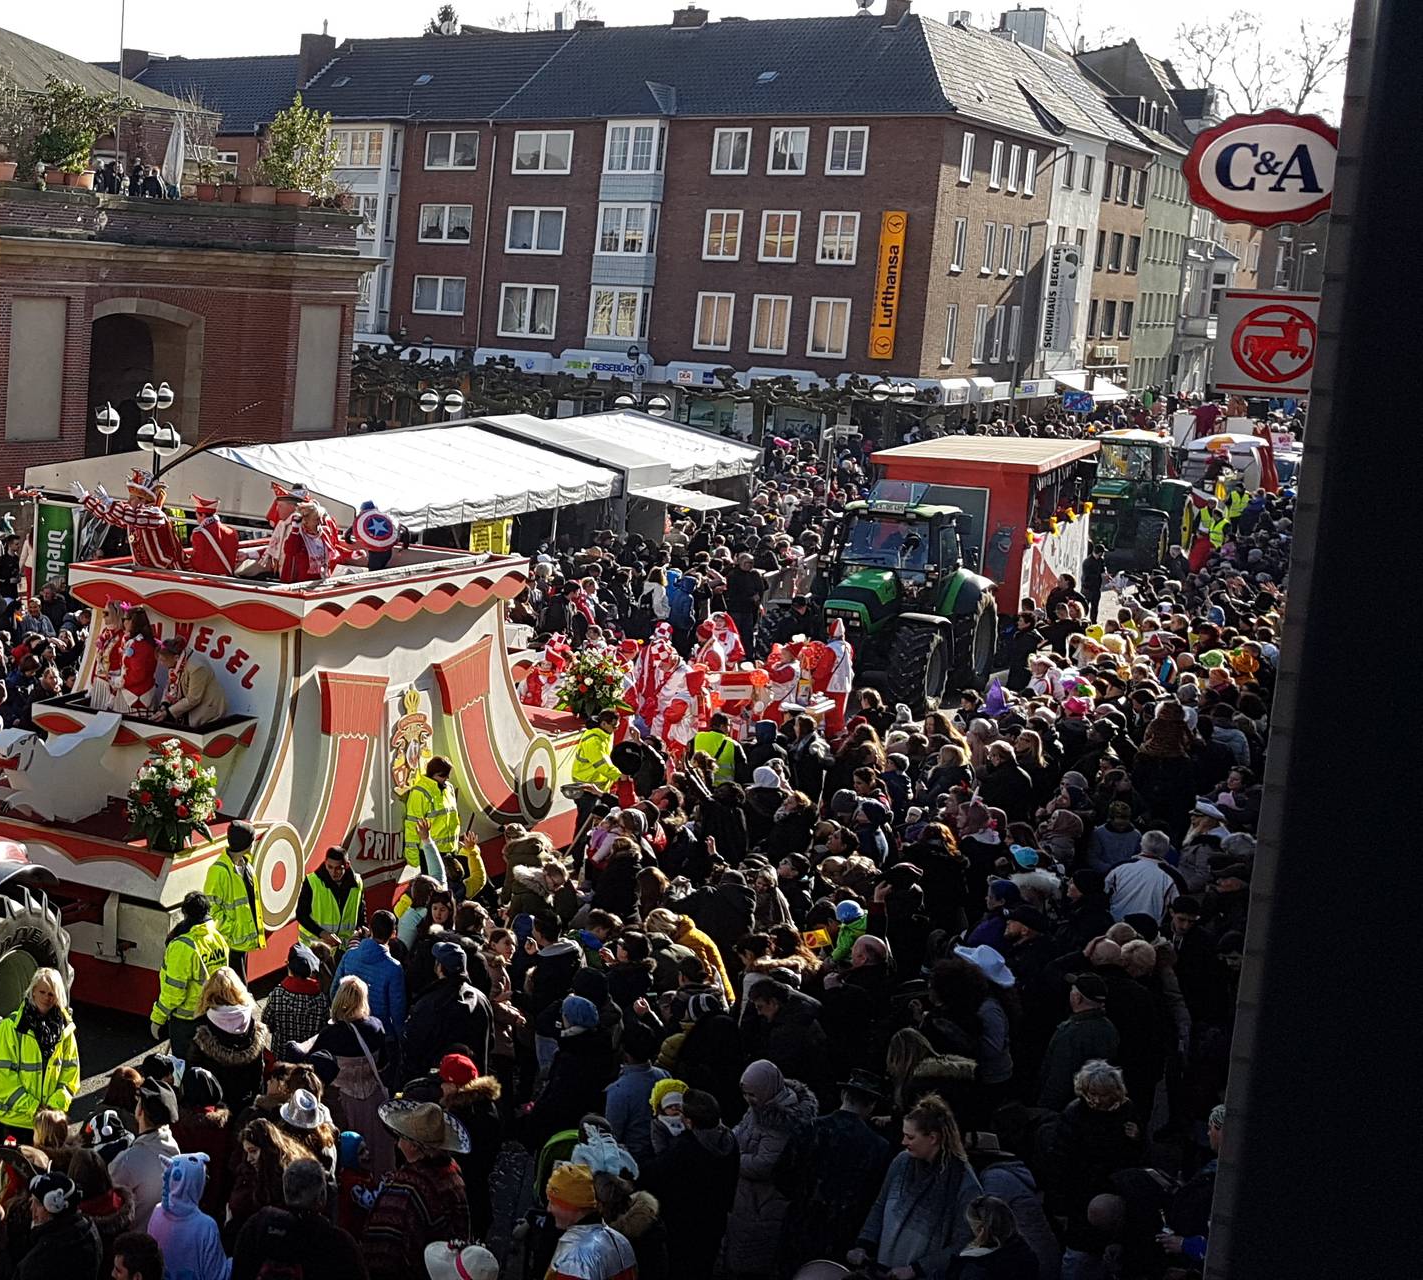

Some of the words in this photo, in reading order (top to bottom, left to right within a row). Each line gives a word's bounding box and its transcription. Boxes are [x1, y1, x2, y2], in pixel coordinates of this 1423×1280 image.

[1215, 142, 1324, 193] C&A
[879, 244, 900, 328] Lufthansa
[1050, 248, 1061, 286] BECKER
[1044, 290, 1057, 348] SCHUHHAUS
[175, 622, 260, 690] WESEL
